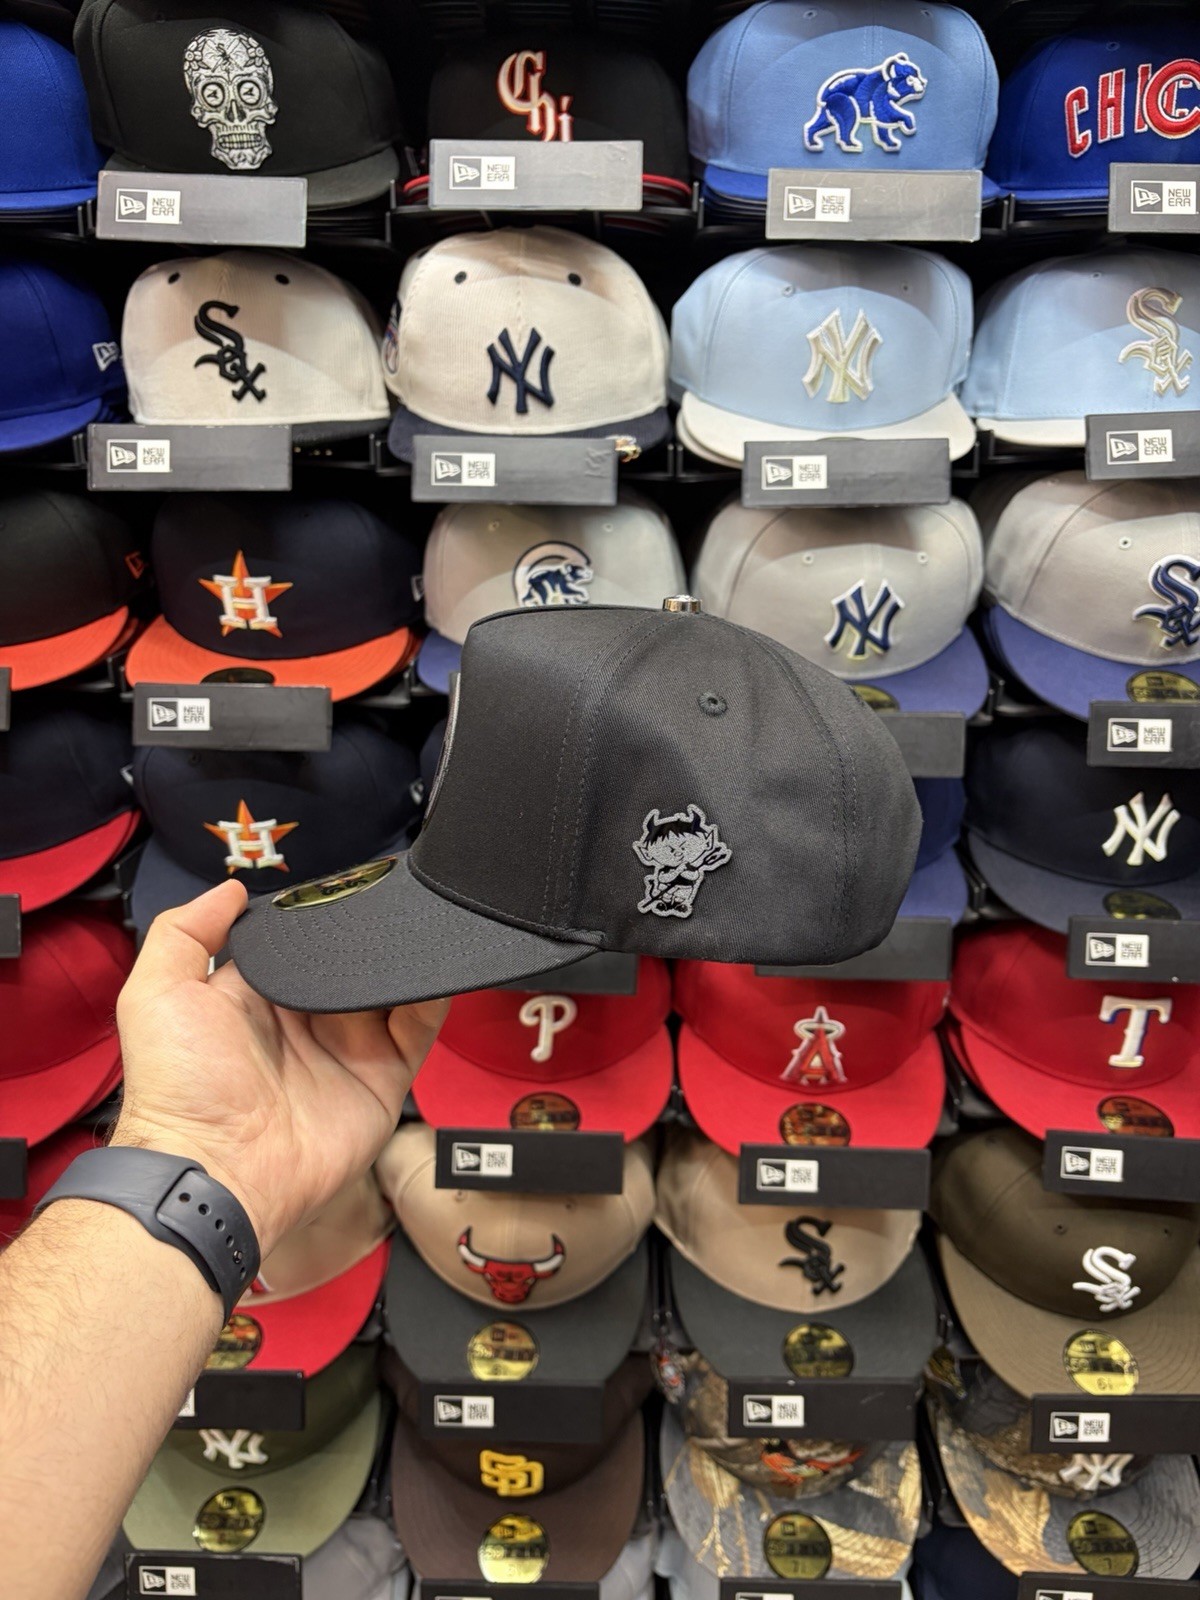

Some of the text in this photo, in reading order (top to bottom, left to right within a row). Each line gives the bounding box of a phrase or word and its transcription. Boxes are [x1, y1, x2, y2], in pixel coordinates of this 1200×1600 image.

[486, 163, 510, 172] NEW
[486, 172, 510, 182] ERA
[1168, 188, 1191, 198] NEW
[152, 198, 175, 207] NEW
[820, 195, 845, 204] NEW
[1168, 197, 1191, 207] ERA
[152, 206, 174, 216] ERA
[820, 204, 845, 215] ERA
[486, 327, 556, 415] NY
[1143, 436, 1167, 447] NEW
[143, 447, 165, 457] NEW
[1144, 446, 1168, 456] ERA
[143, 456, 165, 465] ERA
[467, 460, 490, 470] NEW
[799, 463, 821, 472] NEW
[467, 469, 490, 479] ERA
[824, 579, 906, 660] NY
[1143, 726, 1166, 736] NEW
[1102, 791, 1180, 866] NY
[519, 994, 578, 1061] P
[1099, 995, 1172, 1068] T
[780, 1006, 848, 1084] A
